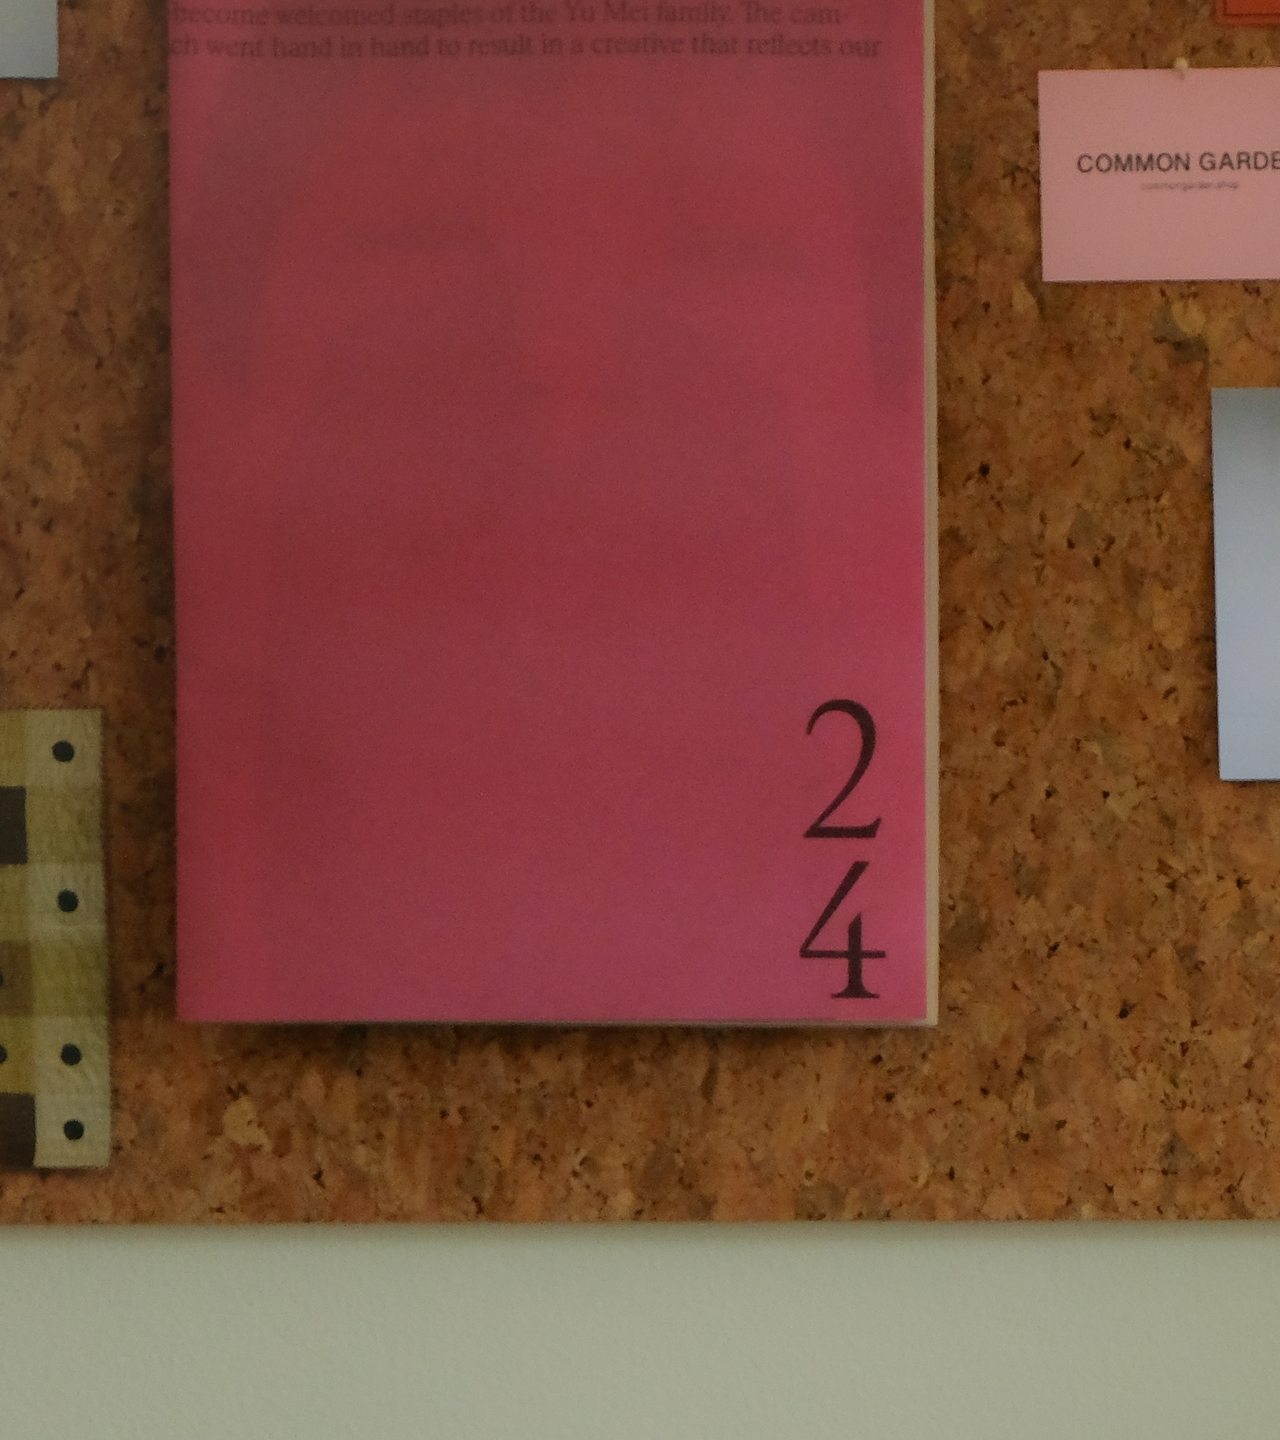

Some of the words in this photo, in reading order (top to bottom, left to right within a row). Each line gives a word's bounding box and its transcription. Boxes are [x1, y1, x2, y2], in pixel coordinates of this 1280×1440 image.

[272, 36, 333, 59] hand
[371, 35, 430, 58] hand
[468, 35, 533, 58] result
[589, 35, 684, 57] creative
[691, 33, 739, 56] that
[837, 38, 884, 58] our
[1076, 152, 1192, 174] COMMON
[803, 698, 882, 839] 2
[800, 860, 887, 999] 4
